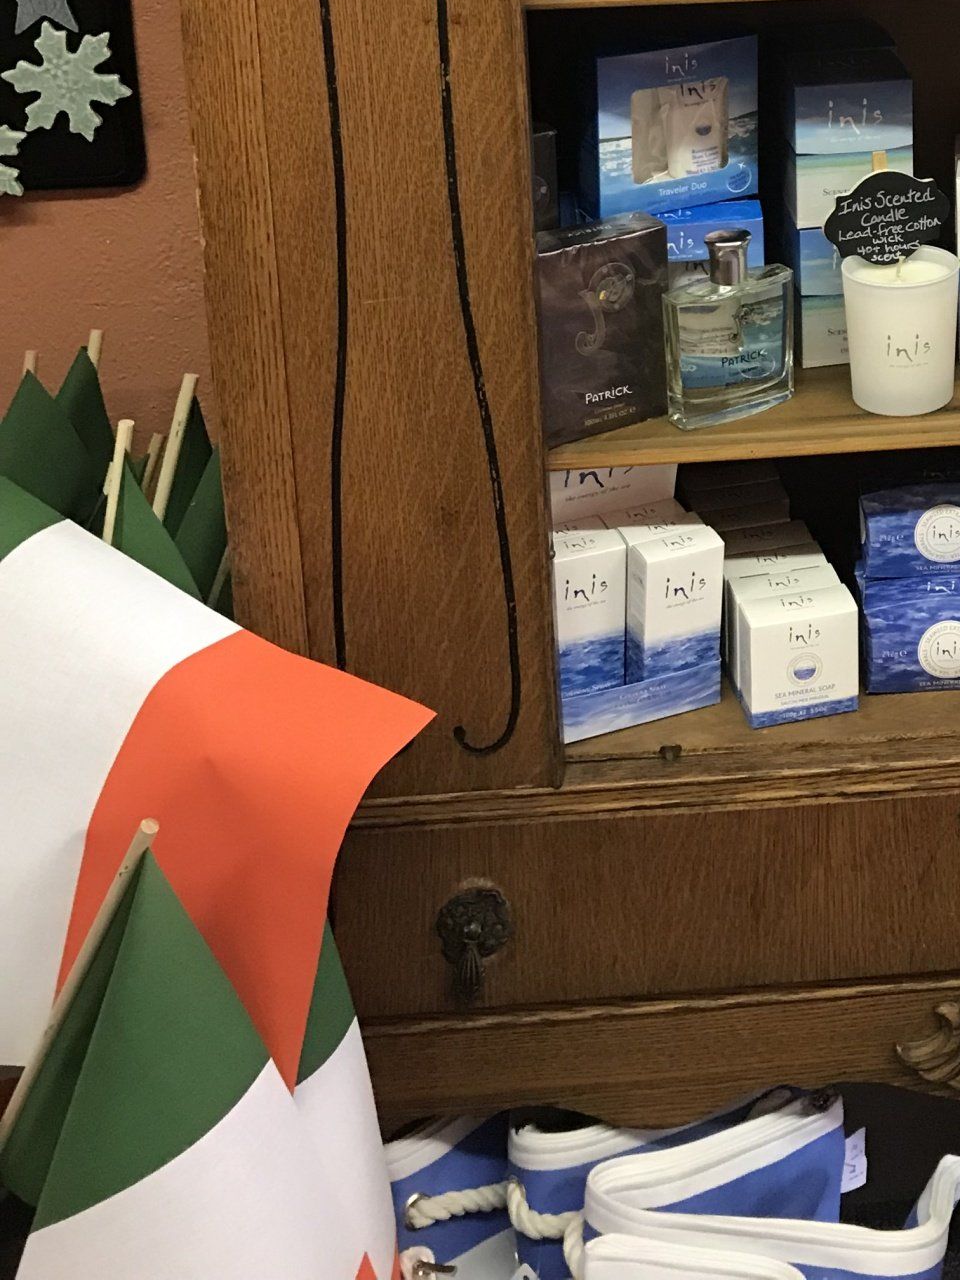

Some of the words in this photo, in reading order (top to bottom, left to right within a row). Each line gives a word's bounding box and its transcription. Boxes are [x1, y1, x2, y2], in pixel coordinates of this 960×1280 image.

[665, 52, 698, 76] inis
[828, 98, 883, 135] inis
[658, 184, 690, 197] Traveler
[691, 182, 706, 192] Duo
[838, 199, 872, 216] Inis
[874, 187, 936, 209] Scented
[860, 208, 910, 227] Candle
[838, 223, 905, 242] Lead-free
[906, 214, 942, 232] cotton
[856, 246, 881, 254] 40+
[884, 240, 922, 252] hours
[872, 234, 904, 245] wick
[870, 251, 902, 262] scent
[886, 334, 932, 362] inis
[720, 349, 766, 368] PATRICK
[585, 384, 633, 404] PATRICK
[576, 492, 599, 500] energy
[663, 535, 694, 548] inis
[932, 524, 960, 542] inis
[564, 538, 596, 549] inis
[564, 574, 608, 602] inis
[666, 571, 707, 600] inis
[780, 596, 814, 608] inis
[788, 624, 821, 644] inis
[788, 688, 816, 697] MINERAL
[818, 683, 836, 692] SOAP
